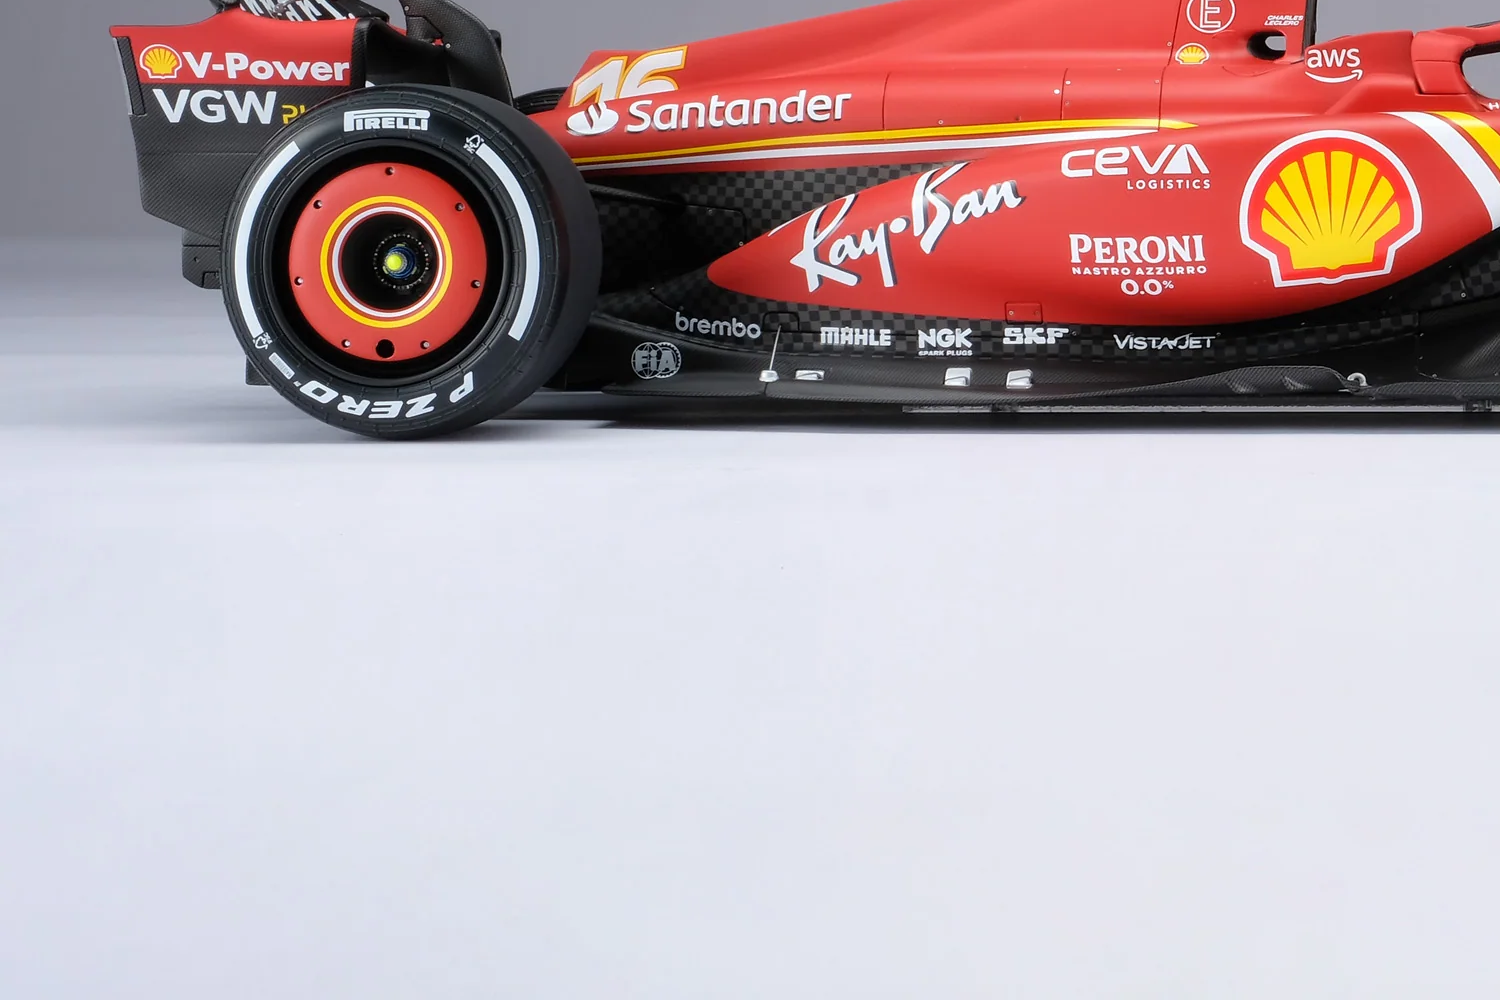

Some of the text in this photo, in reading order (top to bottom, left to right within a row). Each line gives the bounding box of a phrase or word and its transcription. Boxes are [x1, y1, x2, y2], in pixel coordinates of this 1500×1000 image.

[182, 51, 350, 81] V-Power
[1307, 48, 1361, 68] aws
[569, 45, 688, 107] 16
[152, 88, 277, 124] VGW
[625, 89, 852, 133] Santander
[344, 108, 431, 132] PIRELLI
[1127, 179, 1211, 190] LOGISTICS
[1069, 233, 1206, 264] PERONI
[1072, 265, 1207, 276] NASTRO AZZURRO
[1120, 278, 1175, 296] 0.0%
[675, 311, 762, 339] brembo
[820, 326, 892, 347] MAHLE
[918, 328, 973, 349] NGK
[1002, 327, 1070, 346] SKF
[918, 349, 945, 357] SPARK
[300, 371, 474, 419] P ZERO
